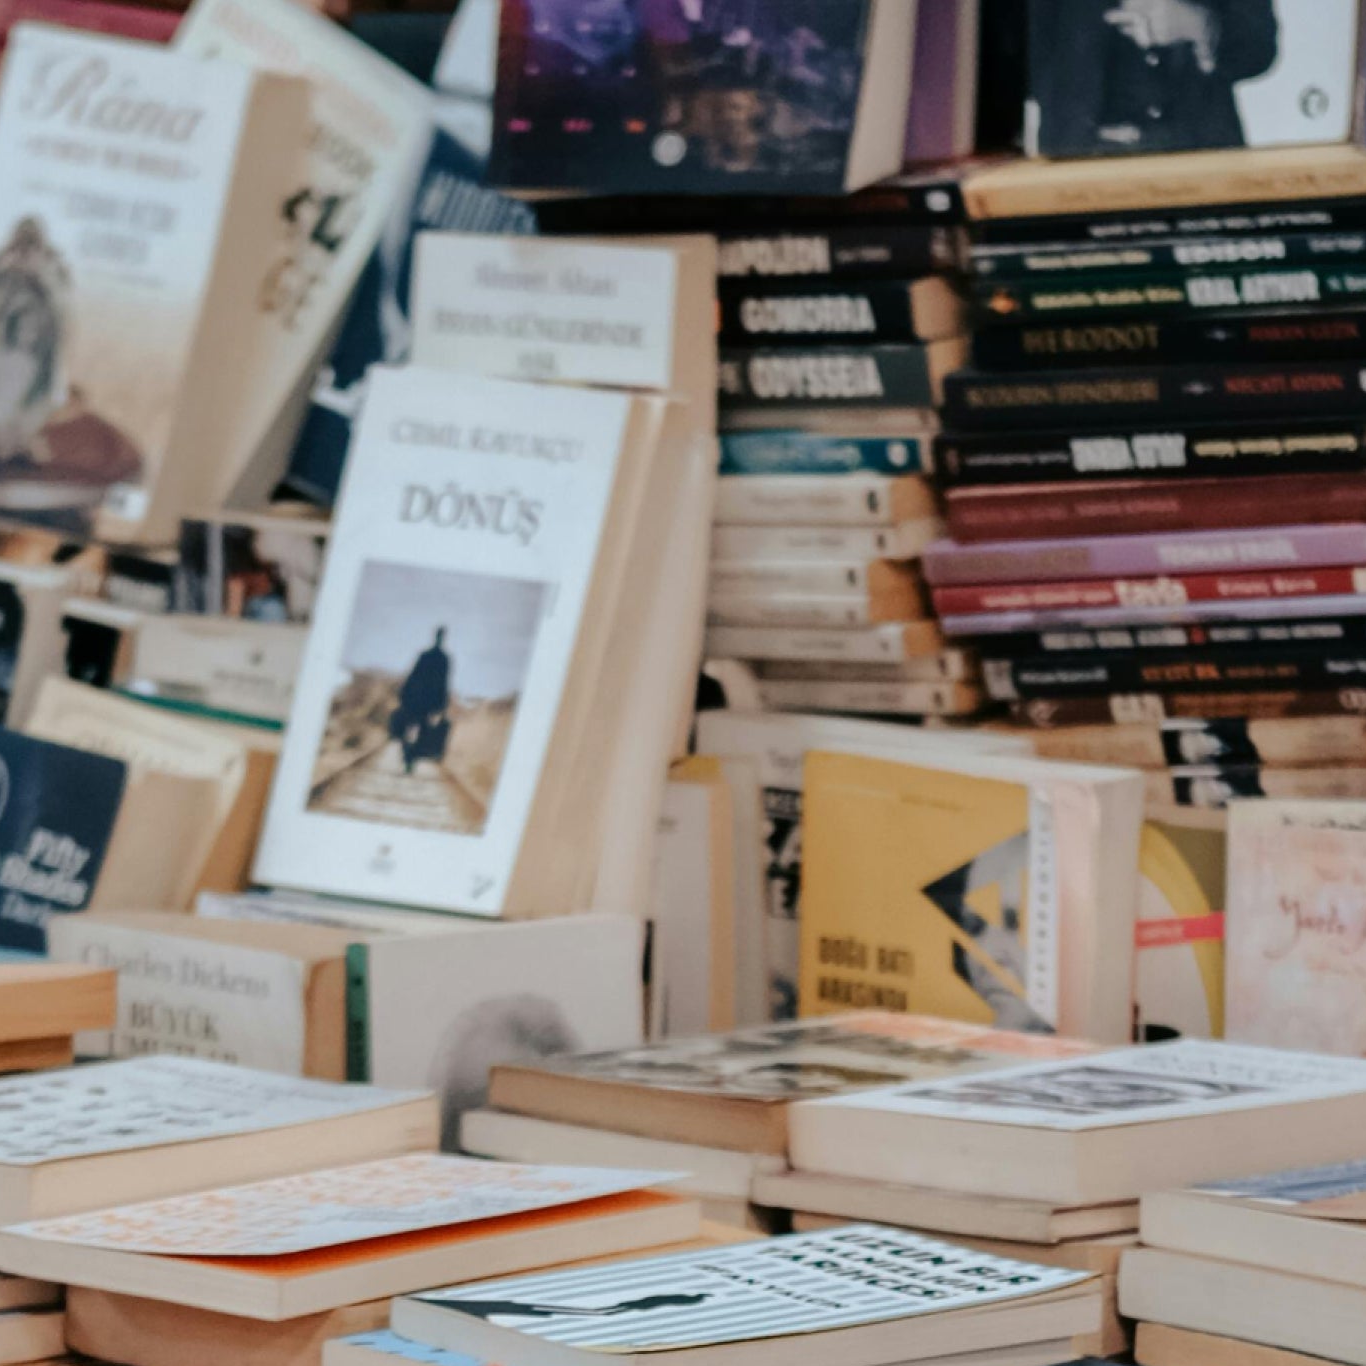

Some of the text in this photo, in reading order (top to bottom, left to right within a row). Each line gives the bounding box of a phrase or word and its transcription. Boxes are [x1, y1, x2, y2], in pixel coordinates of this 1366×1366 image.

[1021, 323, 1160, 355] HERODOT
[399, 480, 545, 547] DÖNÜŞ
[79, 941, 272, 1001] Charles Dickens
[832, 1230, 960, 1265] UZUN
